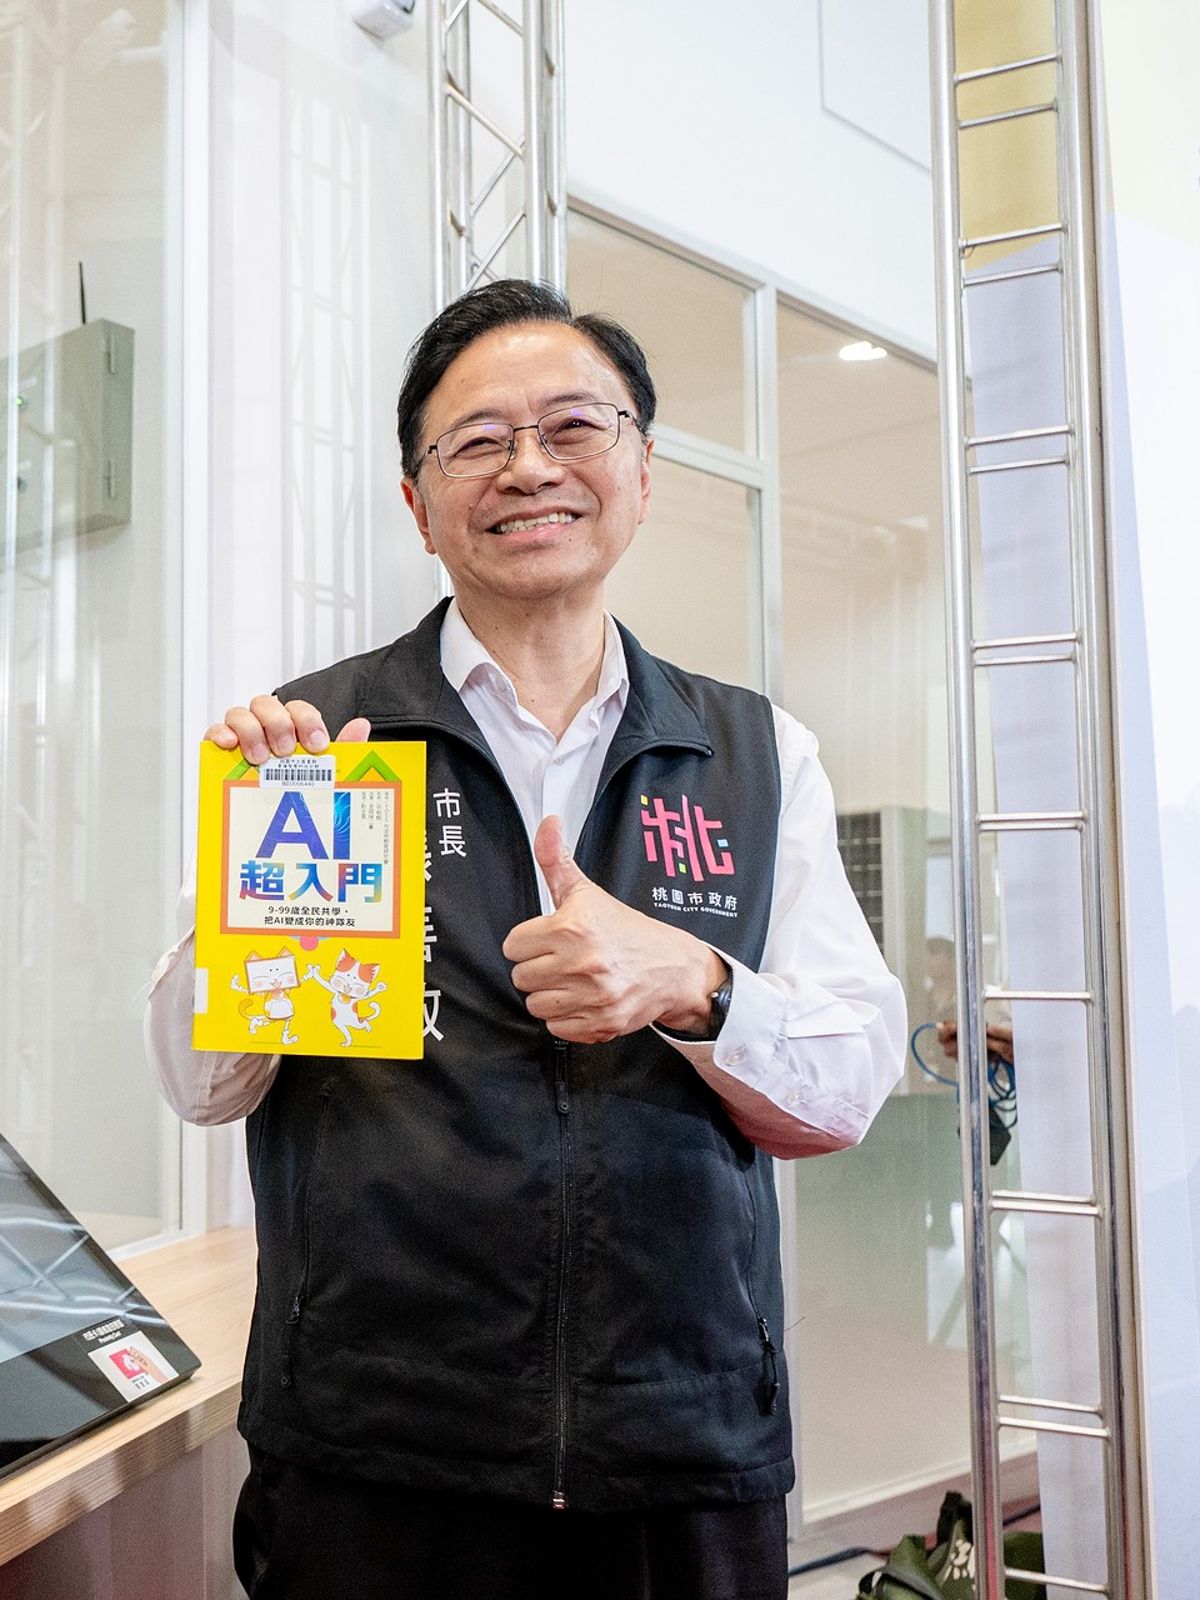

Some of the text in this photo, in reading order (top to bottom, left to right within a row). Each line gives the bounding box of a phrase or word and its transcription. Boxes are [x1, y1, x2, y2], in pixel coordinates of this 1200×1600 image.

[255, 791, 351, 860] AI
[433, 788, 467, 857] 市長
[239, 860, 383, 903] 超入門
[652, 887, 738, 911] 桃園市政府
[653, 902, 682, 911] TAOYUAN
[700, 906, 738, 918] GOVERNMENT
